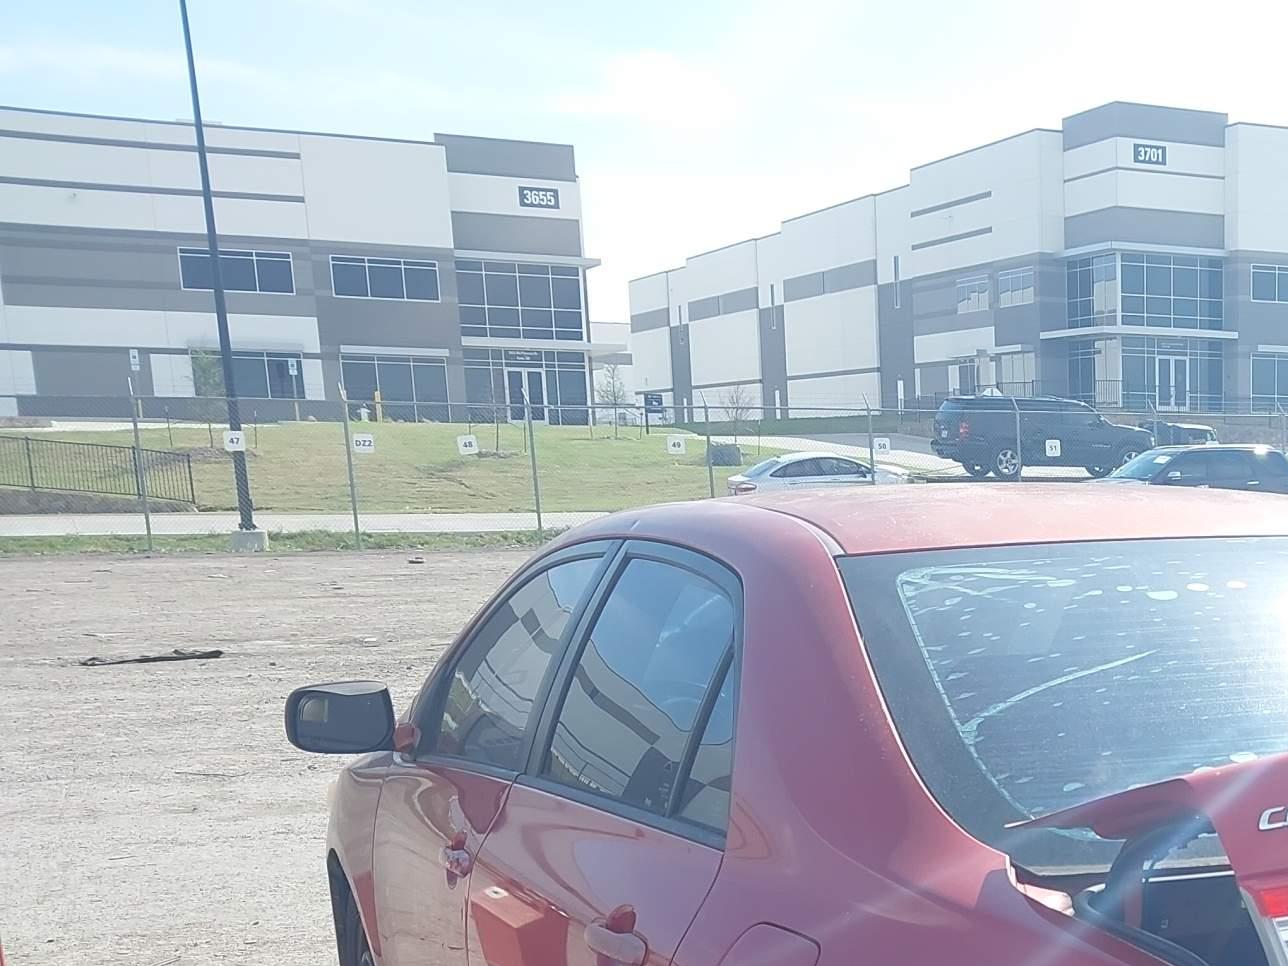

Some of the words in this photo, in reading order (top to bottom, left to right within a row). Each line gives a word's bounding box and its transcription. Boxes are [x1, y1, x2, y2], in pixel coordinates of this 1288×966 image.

[1137, 147, 1163, 162] 3701
[523, 190, 555, 205] 3655
[228, 437, 241, 445] 47
[354, 439, 374, 448] DZ2
[671, 441, 682, 449] 49
